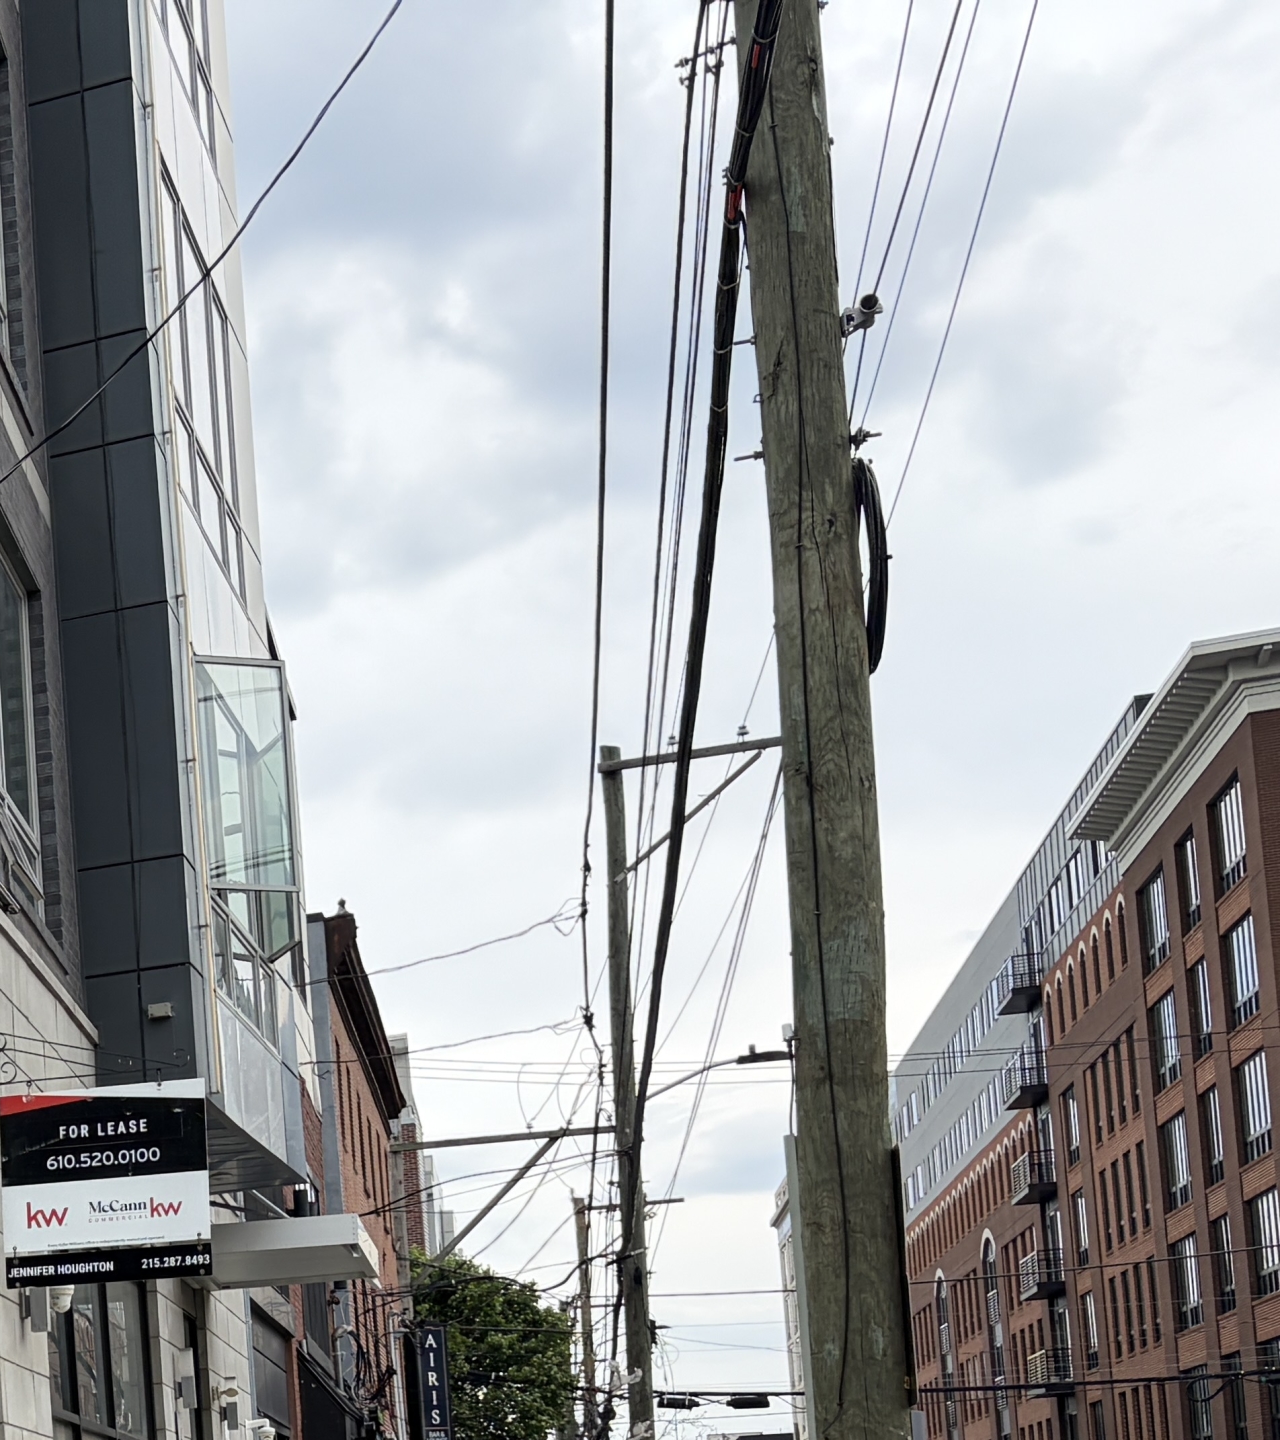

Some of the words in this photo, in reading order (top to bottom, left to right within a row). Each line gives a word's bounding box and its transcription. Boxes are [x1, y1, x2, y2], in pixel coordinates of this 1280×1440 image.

[59, 1123, 89, 1140] FOR
[97, 1119, 148, 1137] LEASE
[46, 1147, 160, 1171] 610.520.0100
[26, 1202, 68, 1229] kw
[88, 1199, 147, 1216] McCann
[149, 1197, 182, 1218] kw
[88, 1213, 149, 1223] COMMERCIAL
[8, 1264, 55, 1279] JENNIFER
[57, 1261, 114, 1275] HOUGHTON
[141, 1253, 211, 1270] 215.287.8493
[425, 1333, 441, 1425] AIRIS
